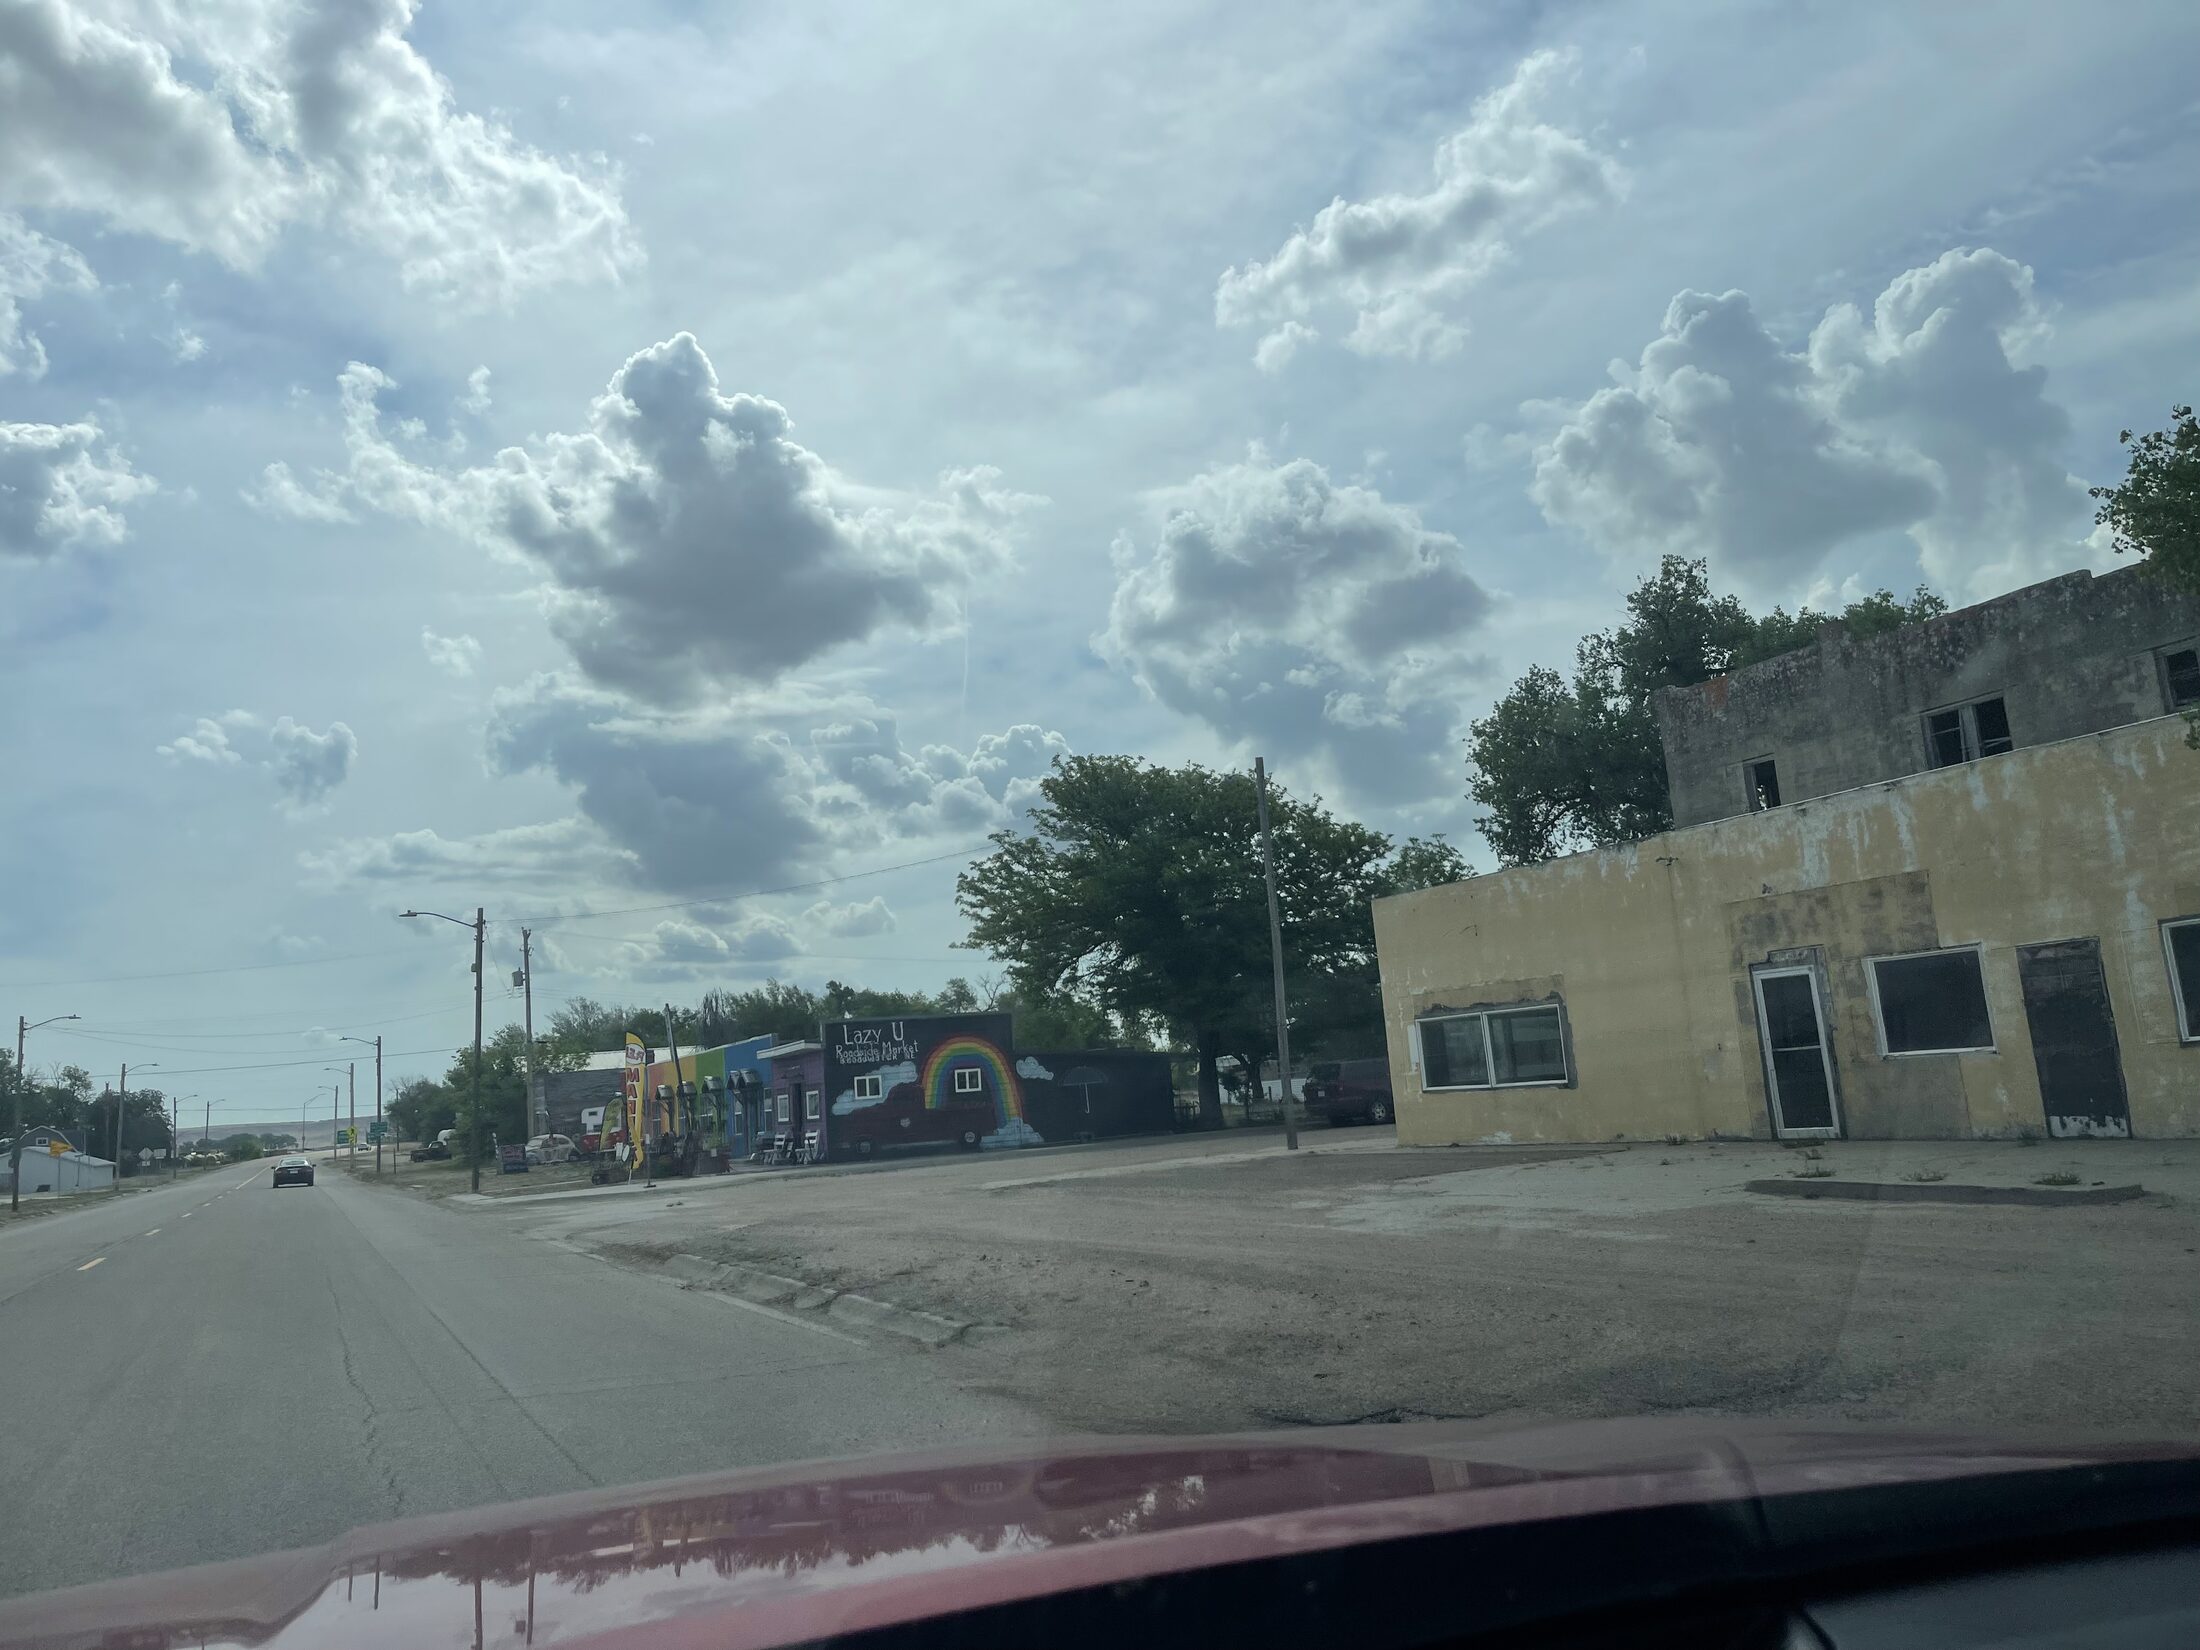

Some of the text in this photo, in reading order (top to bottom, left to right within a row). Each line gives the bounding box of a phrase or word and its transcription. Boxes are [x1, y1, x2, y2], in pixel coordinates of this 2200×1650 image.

[843, 1021, 904, 1045] Lazy U
[835, 1040, 919, 1059] Roadside Market
